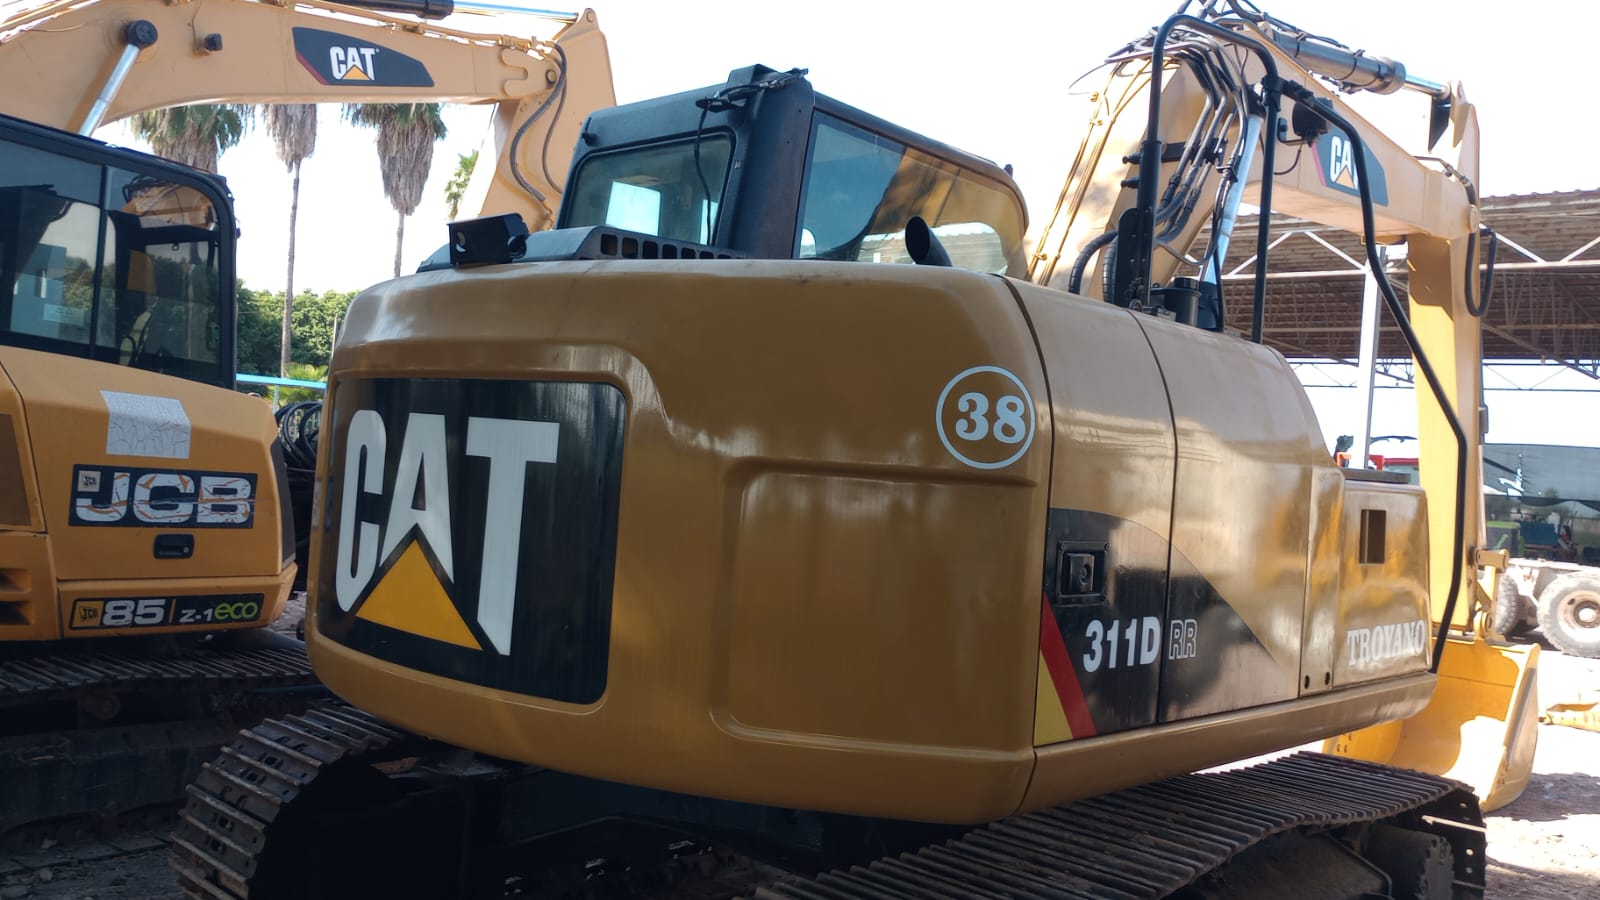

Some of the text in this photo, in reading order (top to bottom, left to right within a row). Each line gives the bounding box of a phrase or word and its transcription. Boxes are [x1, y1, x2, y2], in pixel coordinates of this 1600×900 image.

[329, 46, 376, 80] CAT
[956, 392, 1026, 444] 38
[76, 472, 251, 523] JCB
[336, 410, 560, 656] CAT
[102, 600, 166, 626] 85
[1083, 616, 1198, 673] 311D RR
[1347, 620, 1425, 666] TROYANO
